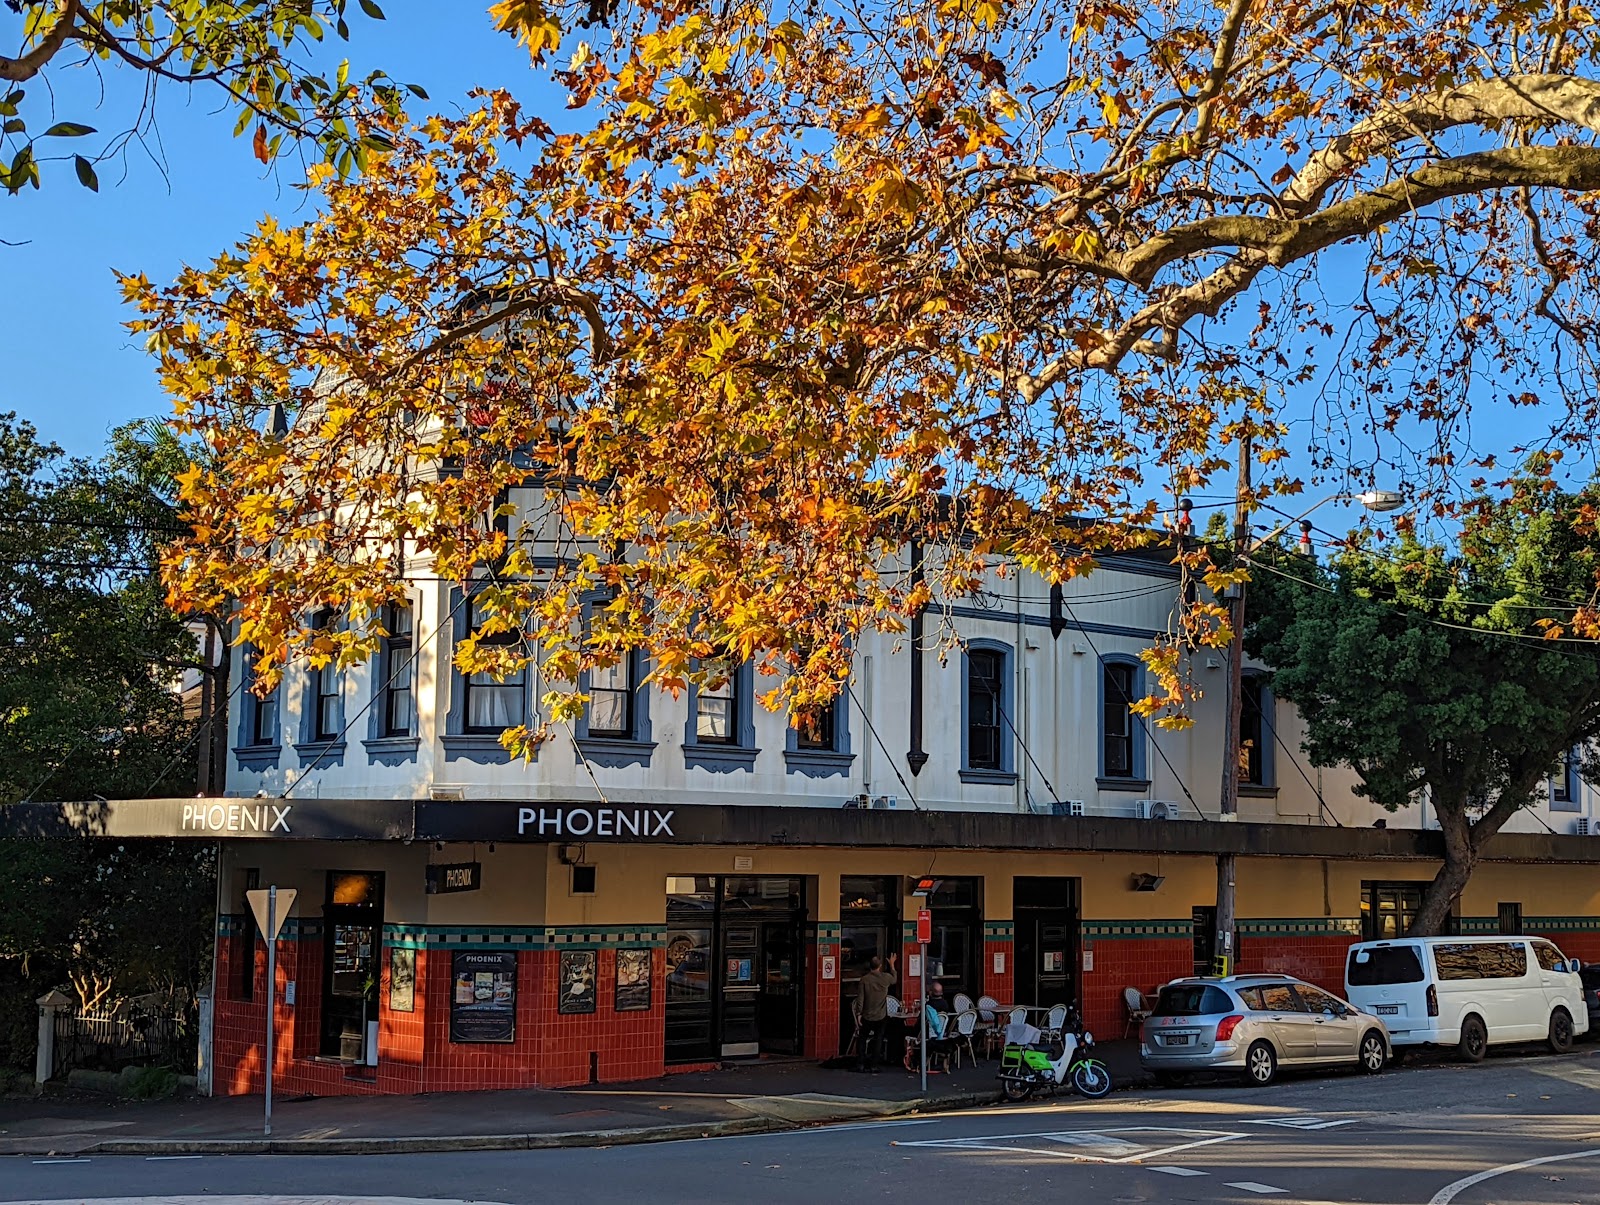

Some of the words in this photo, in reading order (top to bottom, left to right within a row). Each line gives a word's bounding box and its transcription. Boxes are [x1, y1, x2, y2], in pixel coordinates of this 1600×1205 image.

[182, 804, 293, 832] PHOENIX
[518, 807, 675, 836] PHOENIX
[446, 868, 473, 888] PHOENIX
[466, 955, 503, 963] PHOENIX
